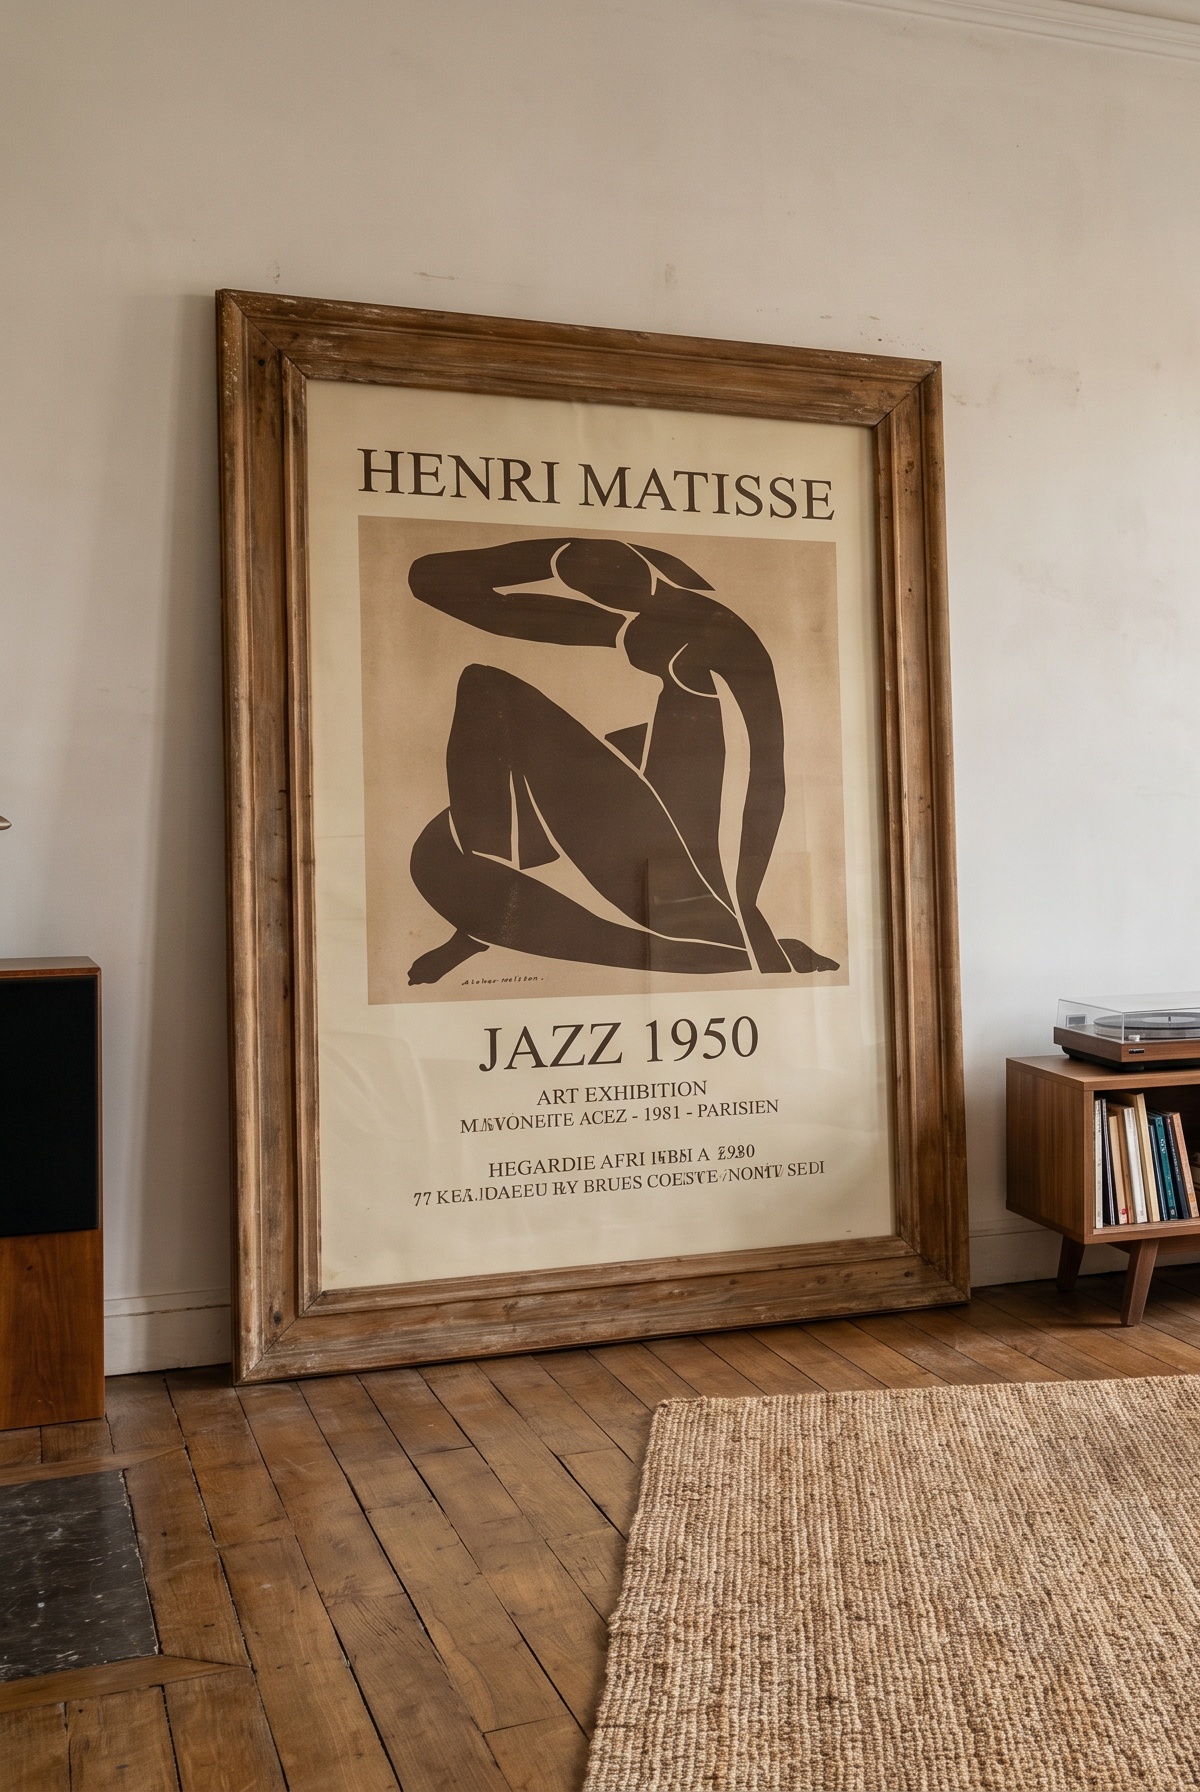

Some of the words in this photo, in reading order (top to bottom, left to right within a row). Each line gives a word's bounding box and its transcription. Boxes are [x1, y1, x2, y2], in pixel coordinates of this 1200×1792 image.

[357, 449, 560, 504] HENRI
[578, 464, 834, 520] MATISSE
[479, 1023, 622, 1071] JAZZ
[646, 1016, 758, 1062] 1950
[537, 1088, 578, 1105] ART
[584, 1080, 707, 1103] EXHIBITION
[579, 1108, 628, 1125] ACEZ
[644, 1105, 681, 1122] 1981
[697, 1099, 779, 1118] PARISIEN
[488, 1155, 596, 1178] HEGARDIE
[600, 1152, 645, 1169] AFRI
[697, 1147, 711, 1162] A
[413, 1191, 432, 1207] 77
[583, 1176, 643, 1194] BRUES
[787, 1160, 825, 1176] SEDI
